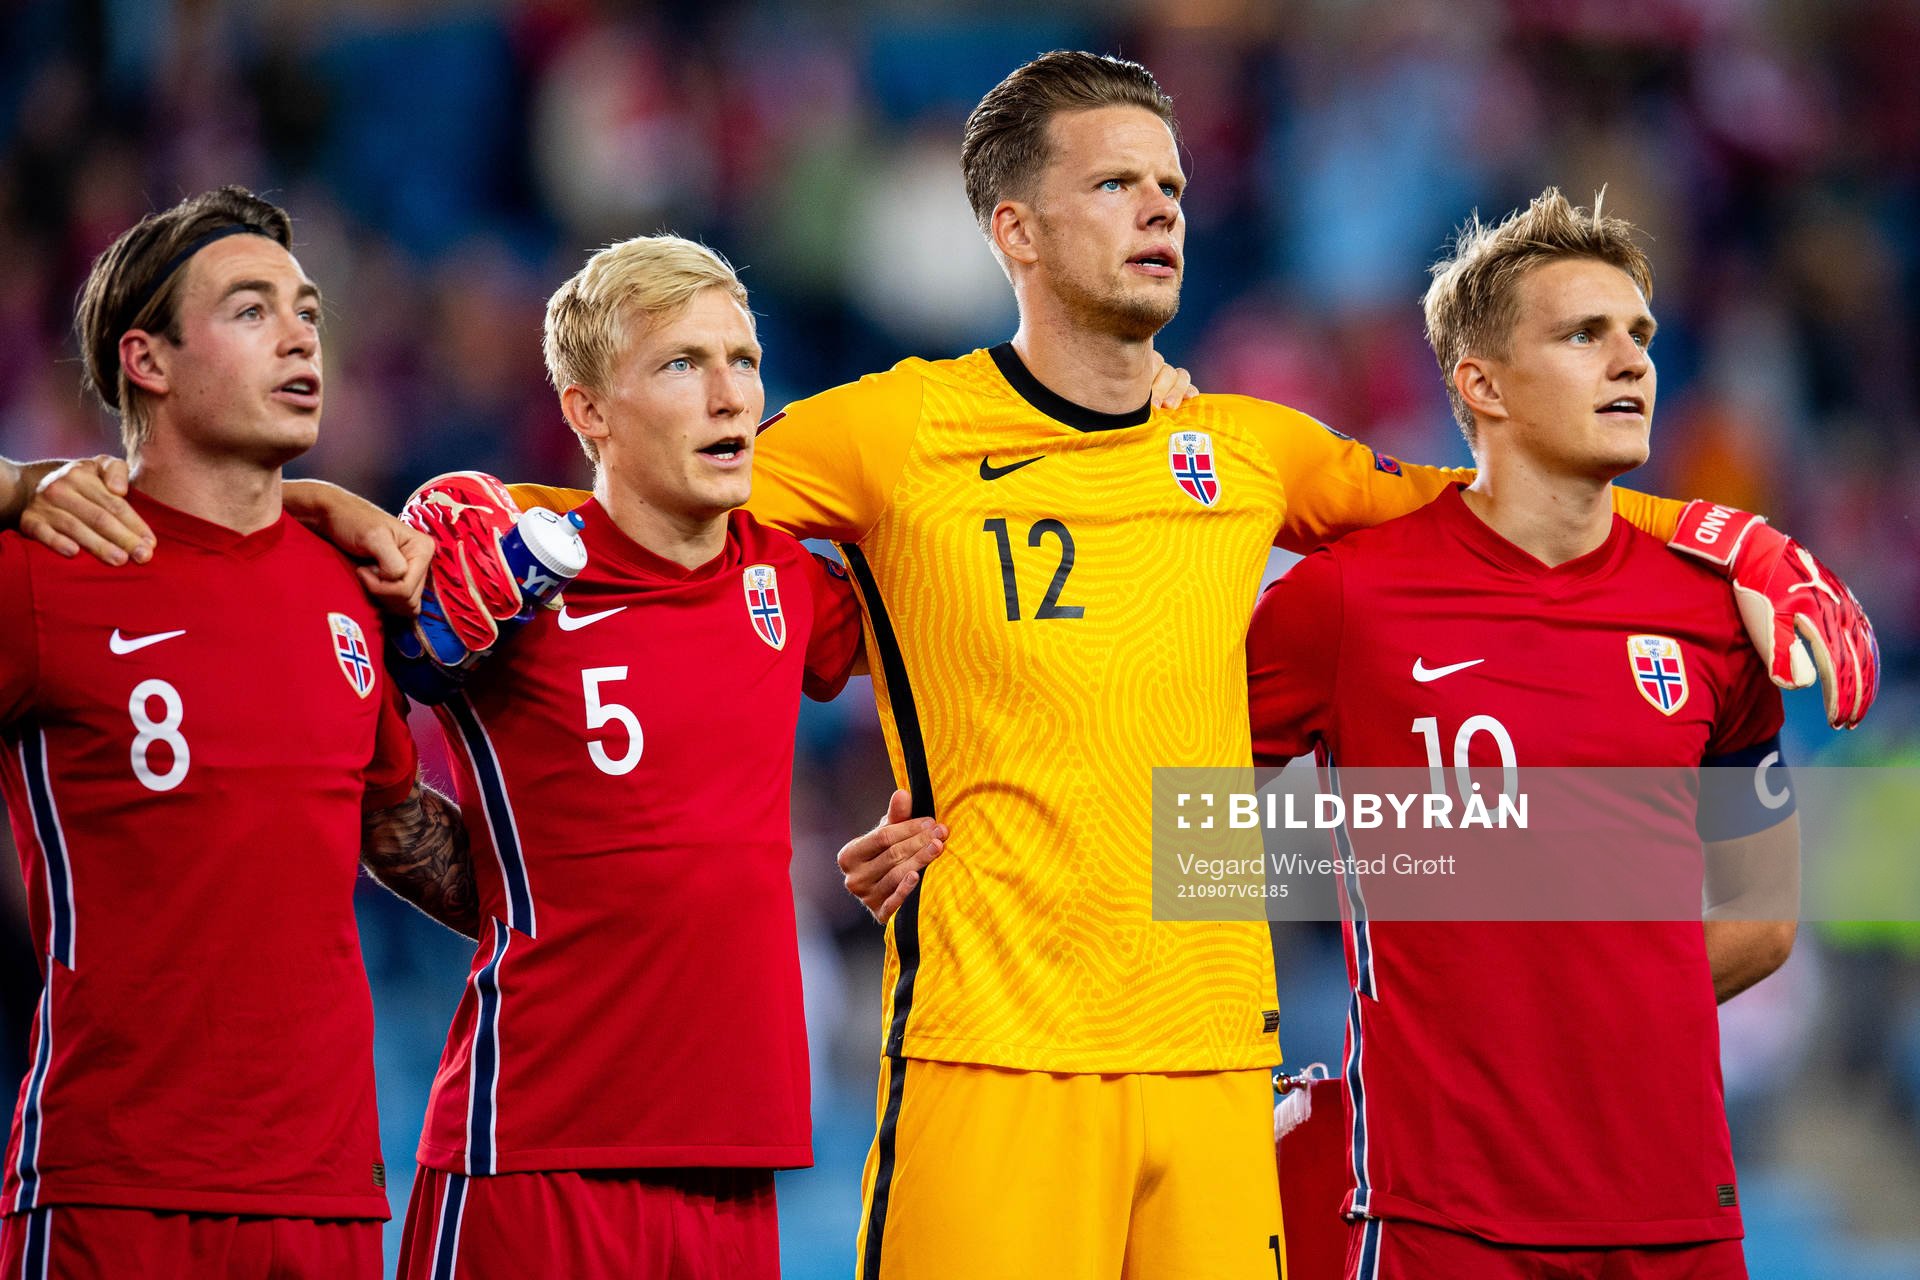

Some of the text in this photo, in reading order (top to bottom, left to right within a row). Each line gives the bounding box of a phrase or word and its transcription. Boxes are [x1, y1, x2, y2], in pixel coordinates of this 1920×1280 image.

[983, 518, 1085, 621] 12
[128, 678, 190, 792] 8
[581, 666, 644, 776] 5
[1411, 714, 1518, 827] 10
[1754, 751, 1790, 809] C
